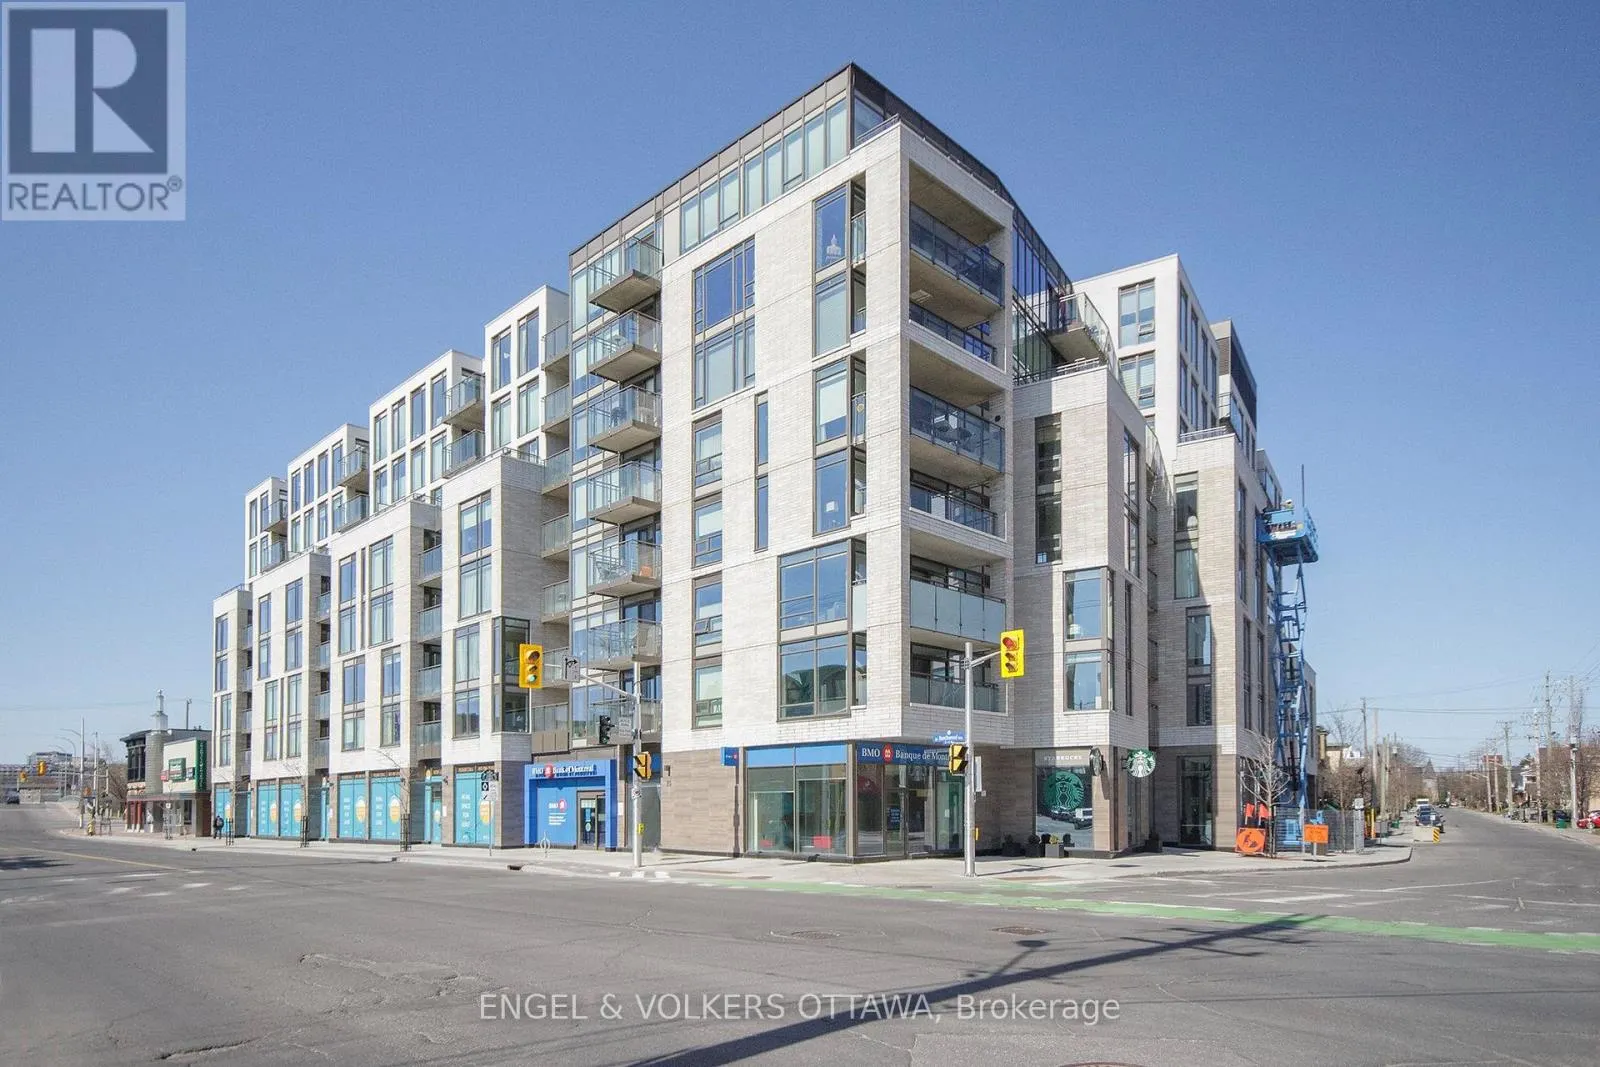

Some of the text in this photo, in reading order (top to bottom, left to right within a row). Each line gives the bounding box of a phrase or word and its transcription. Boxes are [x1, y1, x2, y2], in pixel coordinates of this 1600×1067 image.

[862, 748, 881, 758] BMO
[895, 750, 921, 761] Banque
[922, 749, 931, 760] de
